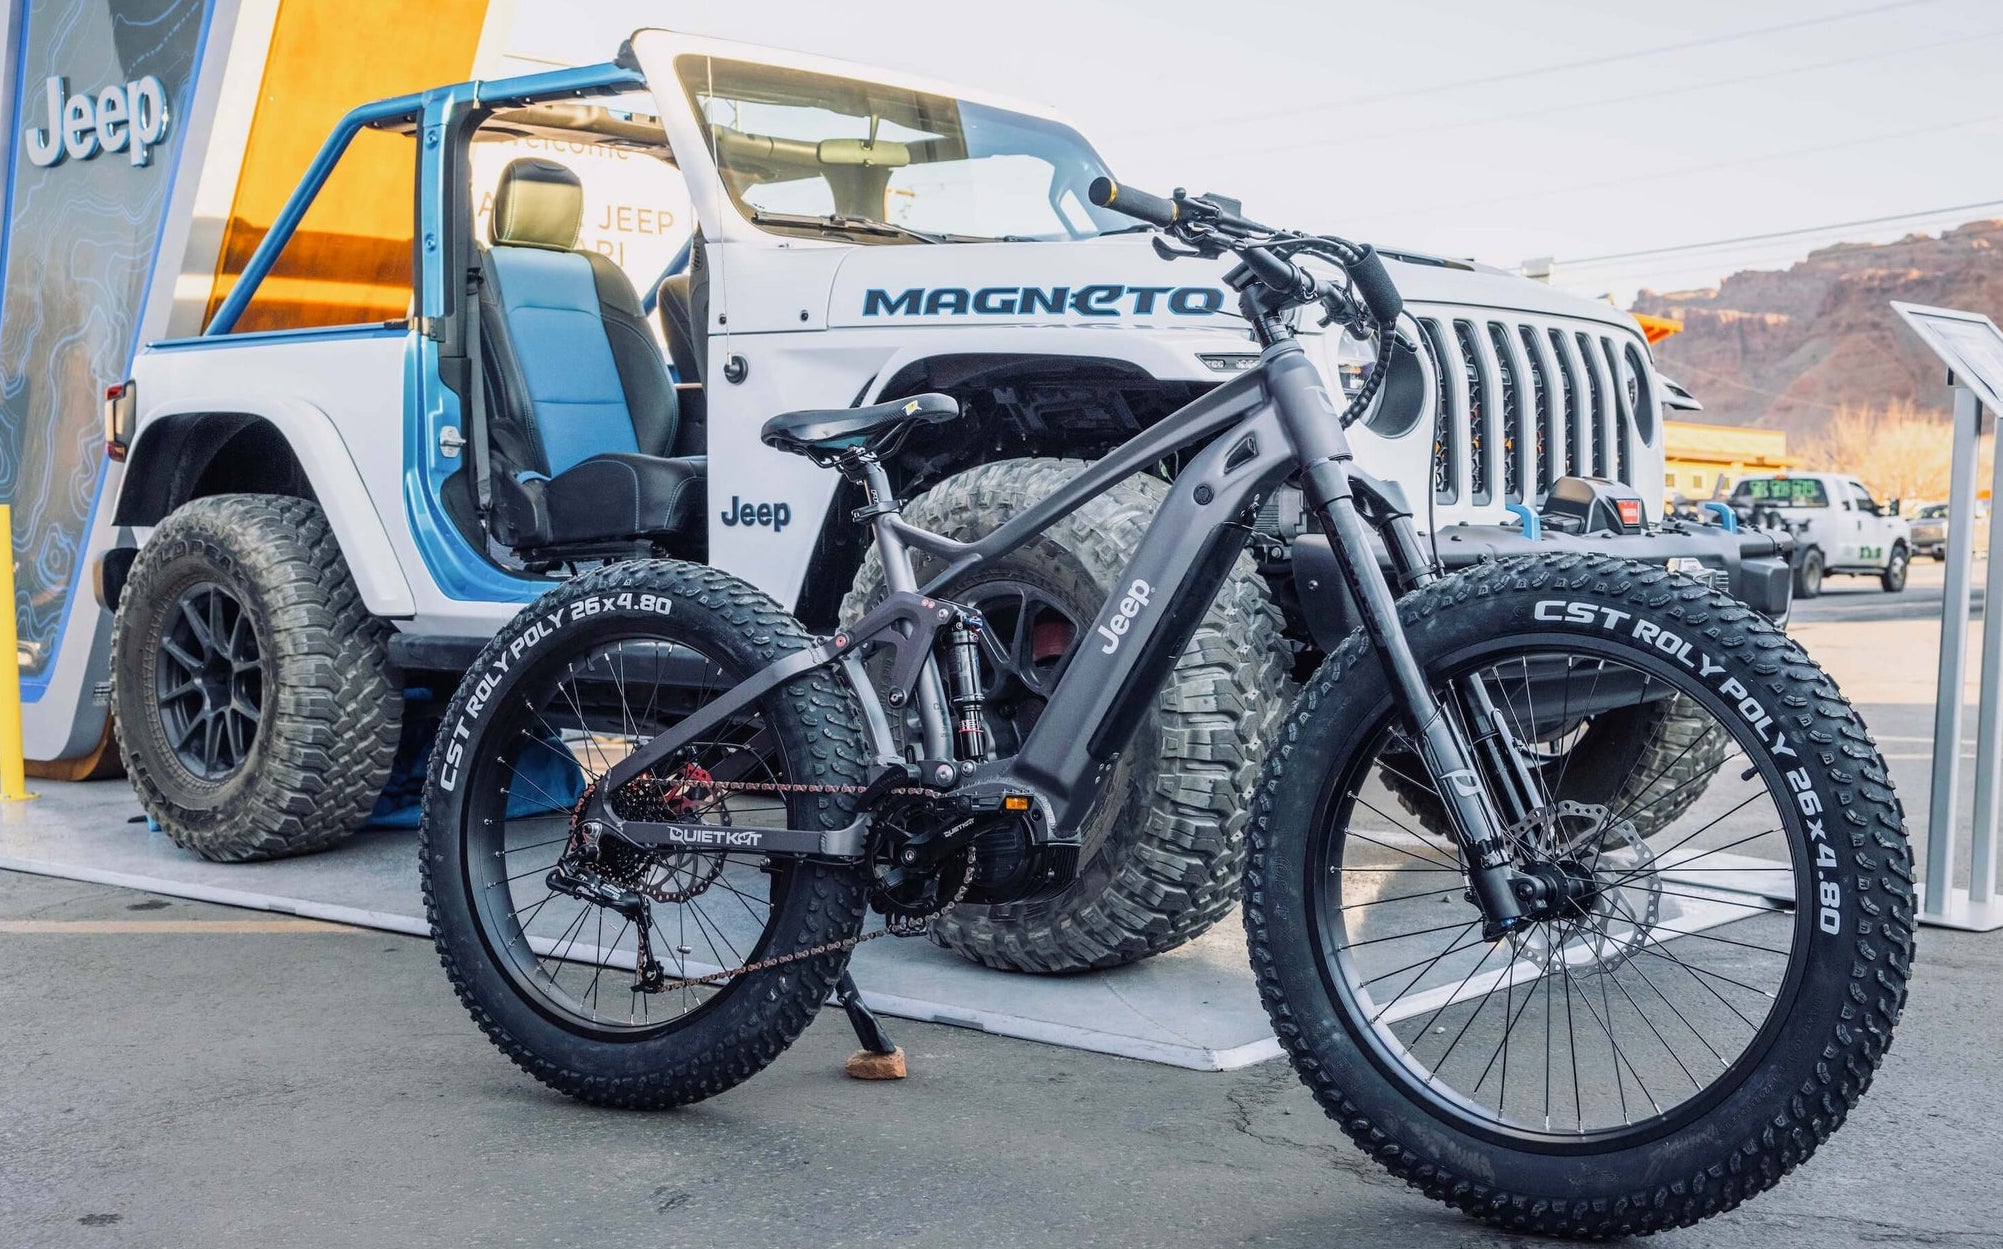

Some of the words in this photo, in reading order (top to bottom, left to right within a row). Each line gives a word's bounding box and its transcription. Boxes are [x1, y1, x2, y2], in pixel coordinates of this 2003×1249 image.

[25, 75, 168, 167] Jeep
[598, 205, 674, 235] JEEP
[721, 495, 791, 533] Jeep
[1097, 578, 1150, 655] Jeep
[440, 716, 471, 792] CST
[465, 651, 510, 719] ROLY
[510, 608, 565, 661] POLY
[570, 592, 672, 621] 26x4.80
[1534, 600, 1631, 630] CST
[1631, 621, 1727, 678] ROLY
[1718, 676, 1798, 761] POLY
[1788, 766, 1841, 935] 26x4.80
[667, 826, 762, 846] QUIETKAT
